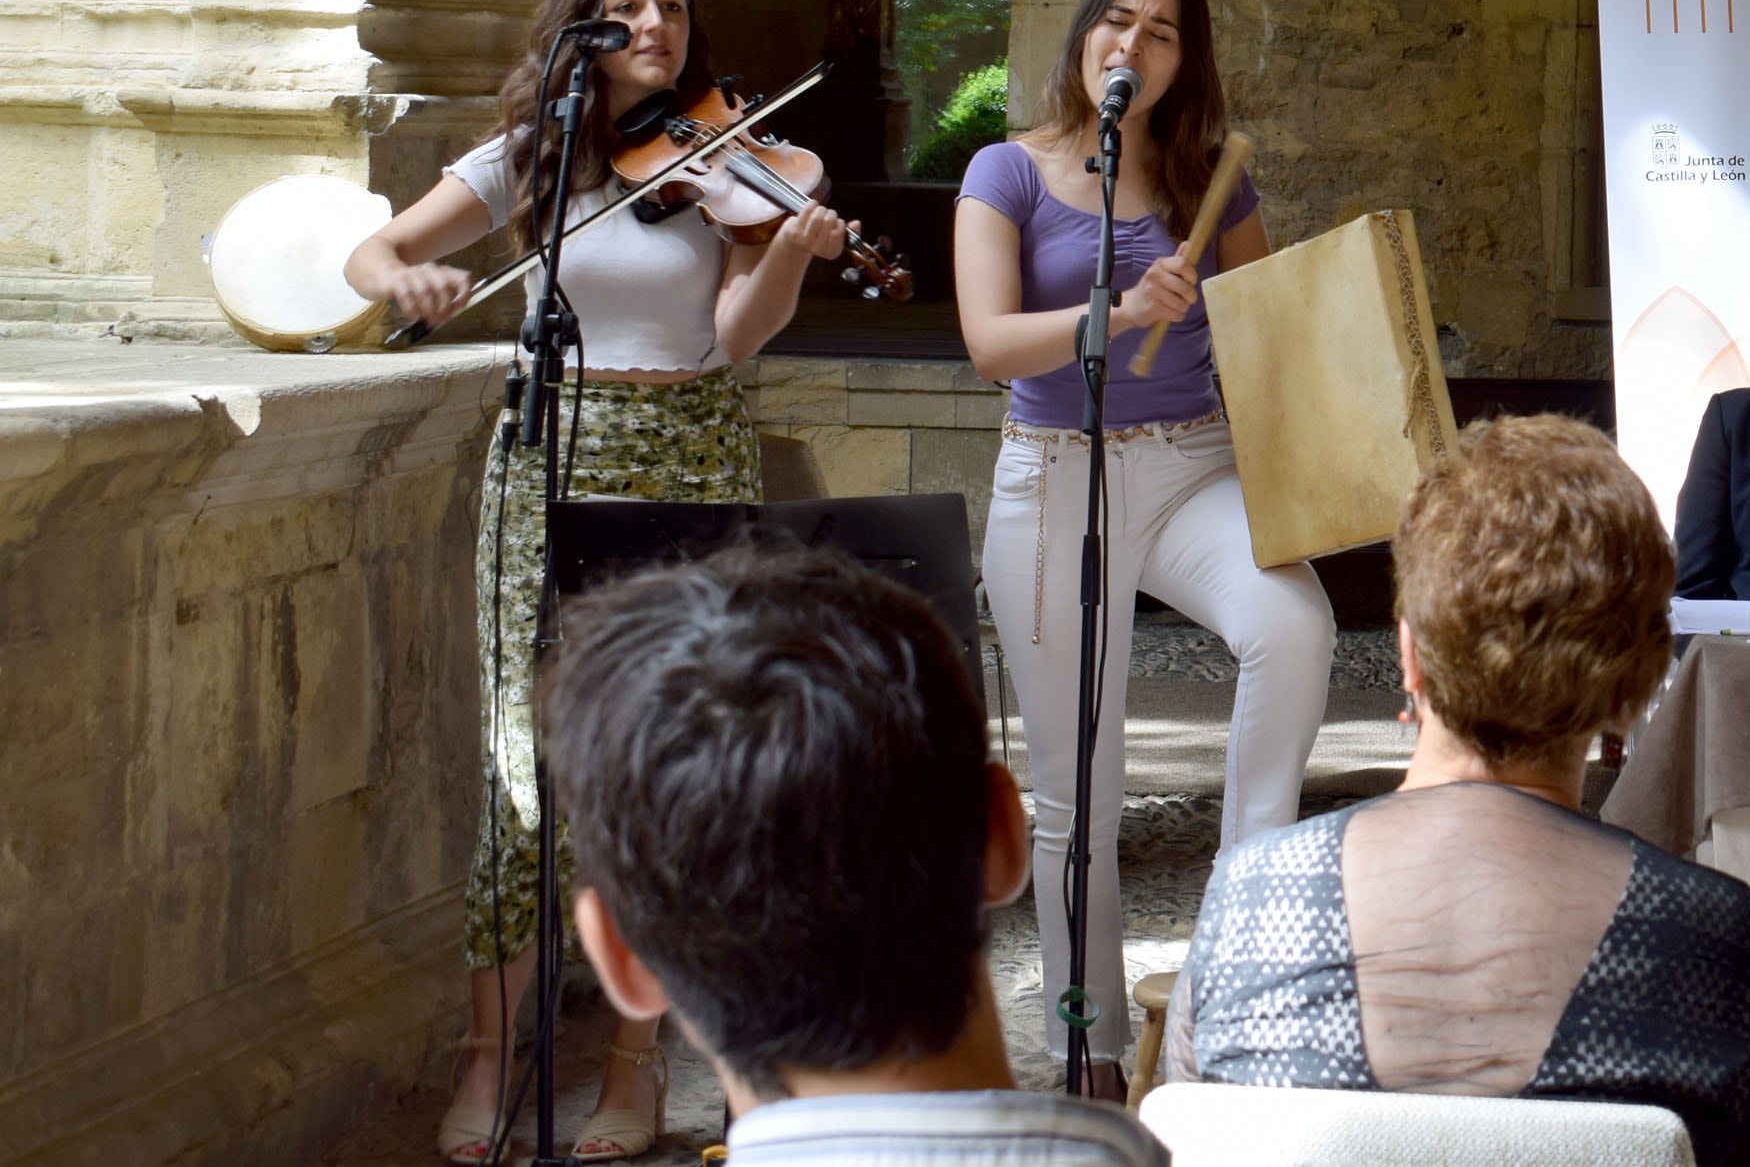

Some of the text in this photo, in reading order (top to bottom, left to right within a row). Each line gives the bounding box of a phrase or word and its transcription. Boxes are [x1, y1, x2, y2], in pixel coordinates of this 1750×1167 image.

[1685, 155, 1745, 167] Junta de
[1645, 170, 1696, 182] Castilla
[1713, 169, 1746, 181] León
